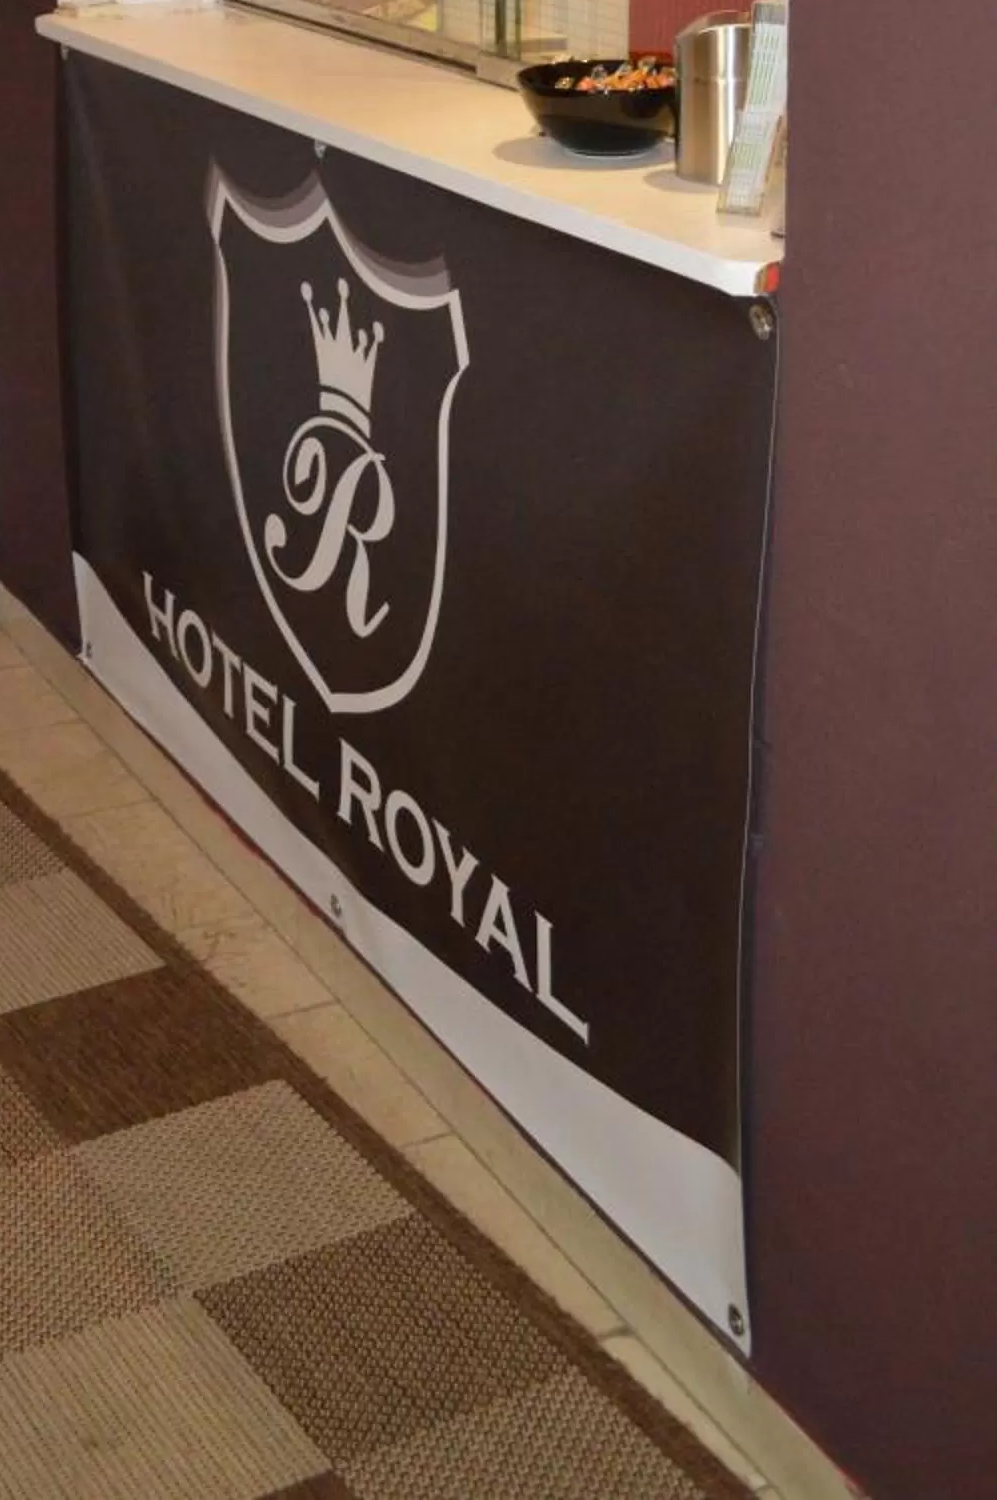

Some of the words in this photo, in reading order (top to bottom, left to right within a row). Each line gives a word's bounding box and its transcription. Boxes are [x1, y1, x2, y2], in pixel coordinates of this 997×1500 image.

[265, 415, 395, 638] R
[143, 570, 321, 801] HOTEL
[337, 738, 590, 1045] ROYAL
